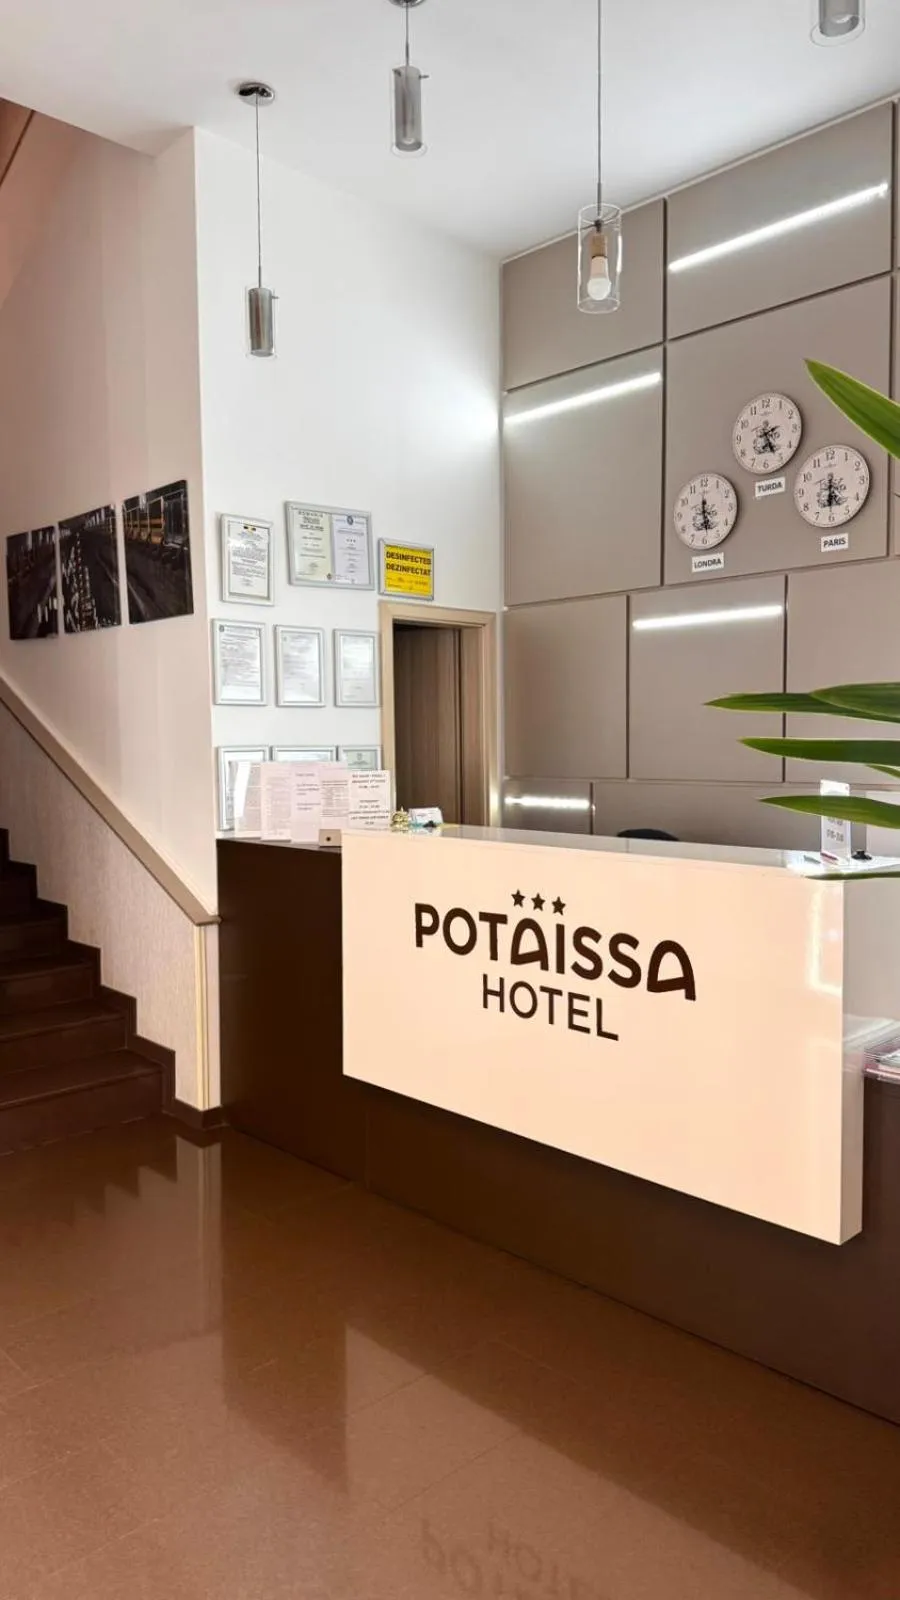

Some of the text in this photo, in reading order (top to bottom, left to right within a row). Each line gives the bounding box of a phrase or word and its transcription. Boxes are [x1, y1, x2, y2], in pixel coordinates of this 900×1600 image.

[762, 399, 770, 408] 12
[779, 401, 782, 409] 1
[751, 406, 756, 415] 11
[788, 410, 793, 419] 2
[741, 420, 748, 429] 10
[737, 435, 741, 444] 9
[826, 450, 835, 461] 12
[845, 452, 848, 462] 1
[749, 458, 755, 467] 7
[763, 460, 769, 468] 6
[813, 458, 820, 468] 11
[855, 461, 860, 471] 2
[804, 472, 812, 482] 10
[859, 476, 864, 484] 3
[701, 478, 708, 487] 12
[716, 480, 719, 489] 1
[758, 481, 783, 493] TURDA
[690, 485, 695, 494] 11
[799, 489, 804, 497] 9
[855, 492, 859, 501] 4
[803, 503, 809, 511] 8
[844, 506, 849, 515] 5
[815, 512, 820, 521] 7
[828, 513, 835, 522] 6
[689, 534, 694, 545] 7
[823, 538, 846, 548] PARIS
[694, 558, 722, 569] LONDRA
[385, 562, 431, 576] DEZINFECTAT
[415, 903, 696, 1002] POTAISSA
[483, 974, 619, 1042] HOTEL
